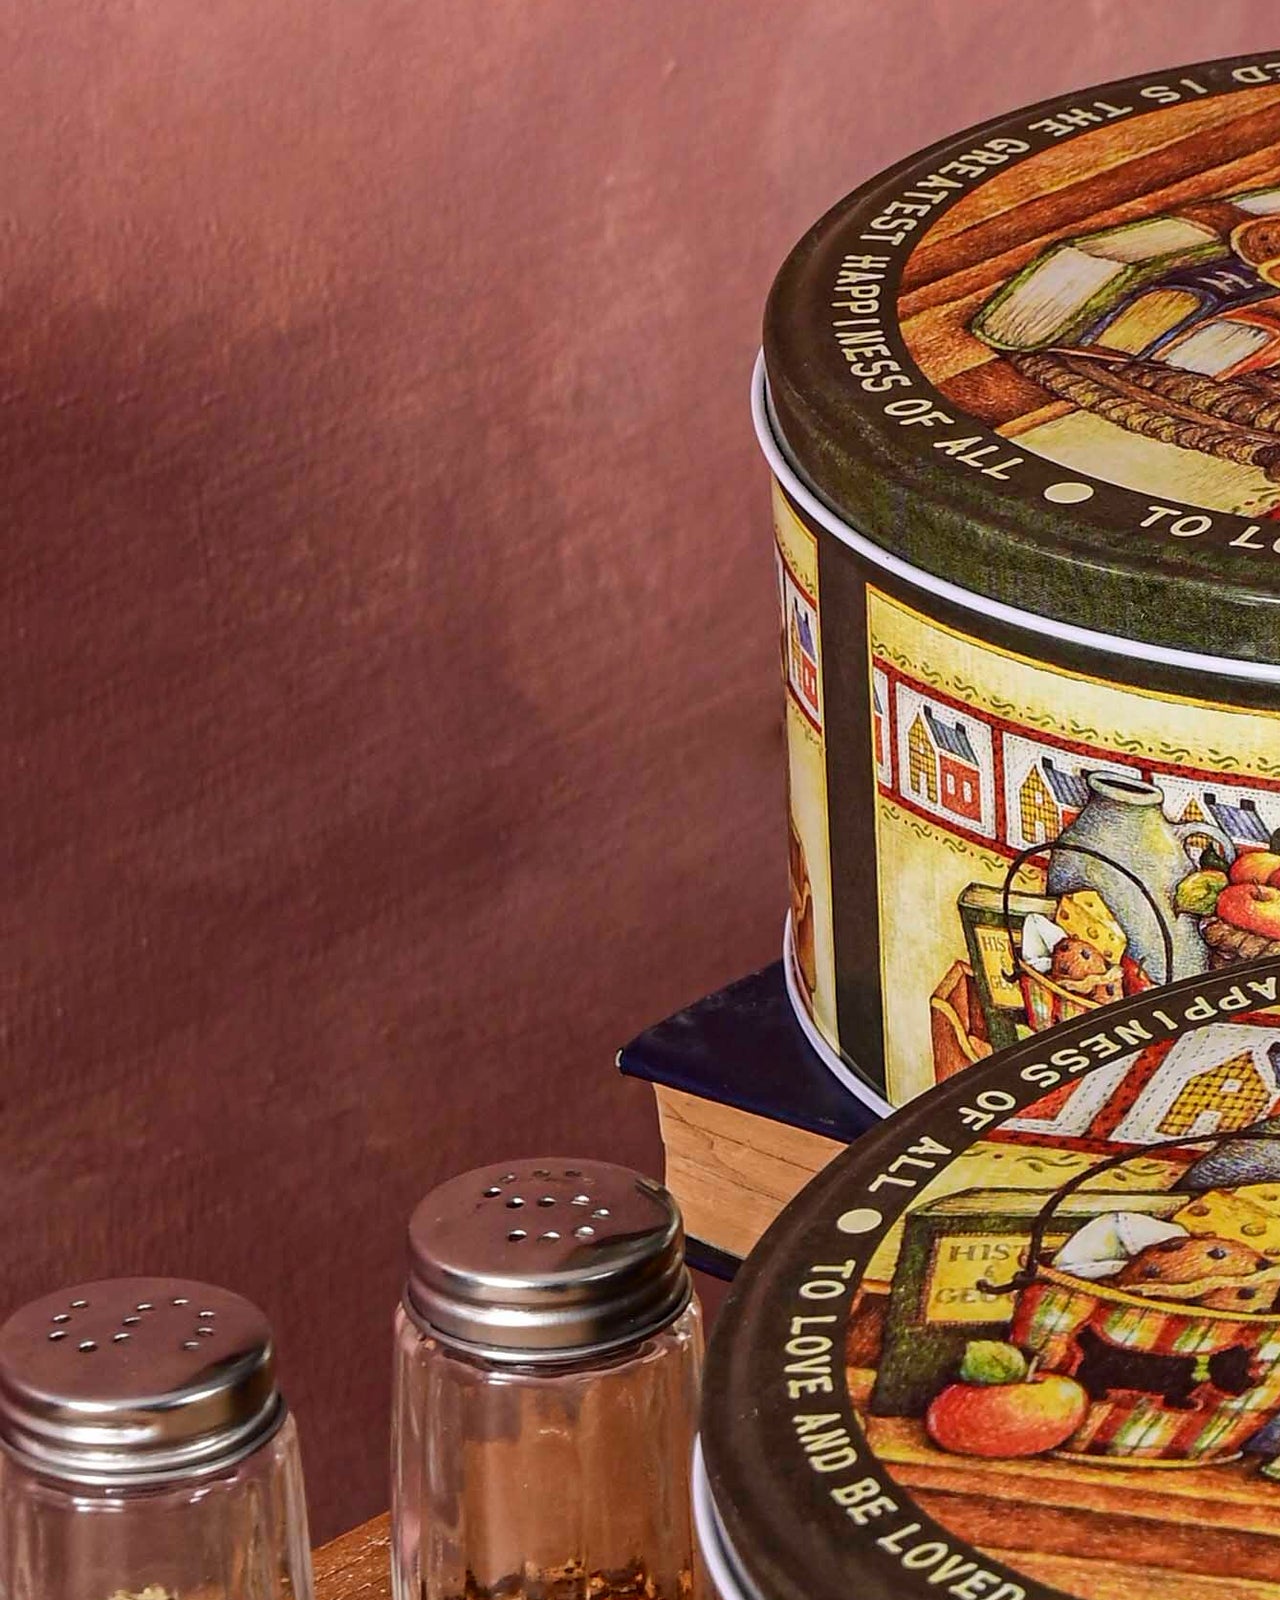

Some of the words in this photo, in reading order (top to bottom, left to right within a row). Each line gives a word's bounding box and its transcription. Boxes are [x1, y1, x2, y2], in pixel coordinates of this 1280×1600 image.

[1139, 78, 1208, 104] IS
[1027, 100, 1133, 137] THE
[858, 137, 1030, 246] GREATEST
[830, 253, 913, 392] HAPPINESS
[882, 398, 955, 427] OF
[931, 435, 1024, 480] ALL
[1138, 504, 1213, 537] TO
[957, 1089, 1016, 1131] OF
[866, 1135, 952, 1193] ALL
[798, 1258, 856, 1300] TO
[782, 1314, 838, 1399] LOVE
[791, 1412, 858, 1473] AND
[829, 1476, 899, 1525] BE
